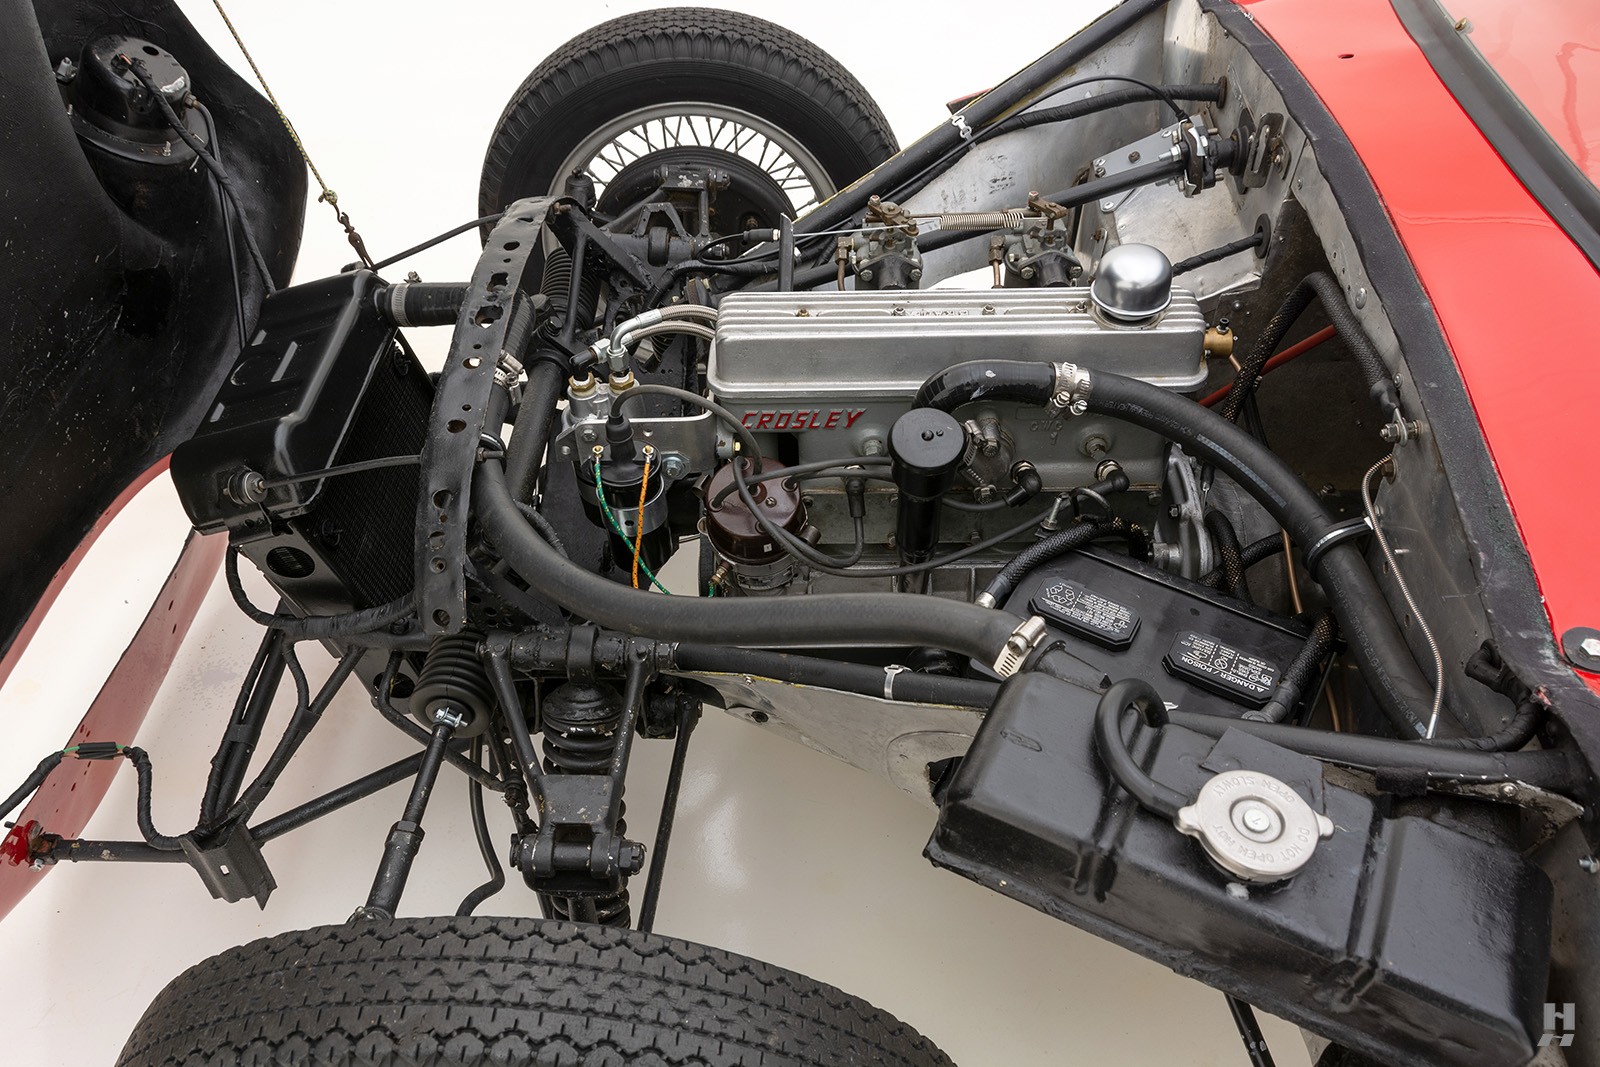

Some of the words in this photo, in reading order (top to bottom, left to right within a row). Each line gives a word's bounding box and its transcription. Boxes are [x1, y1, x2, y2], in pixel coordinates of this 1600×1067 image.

[741, 408, 868, 430] CROSLEY
[1182, 656, 1212, 673] POISON
[1220, 672, 1256, 690] DANGER
[1213, 776, 1255, 797] SLOWLY
[1263, 778, 1295, 803] OPEN
[1212, 824, 1236, 846] HOT
[1298, 827, 1310, 843] DO
[1239, 845, 1275, 863] OPEN
[1281, 844, 1303, 861] NOT
